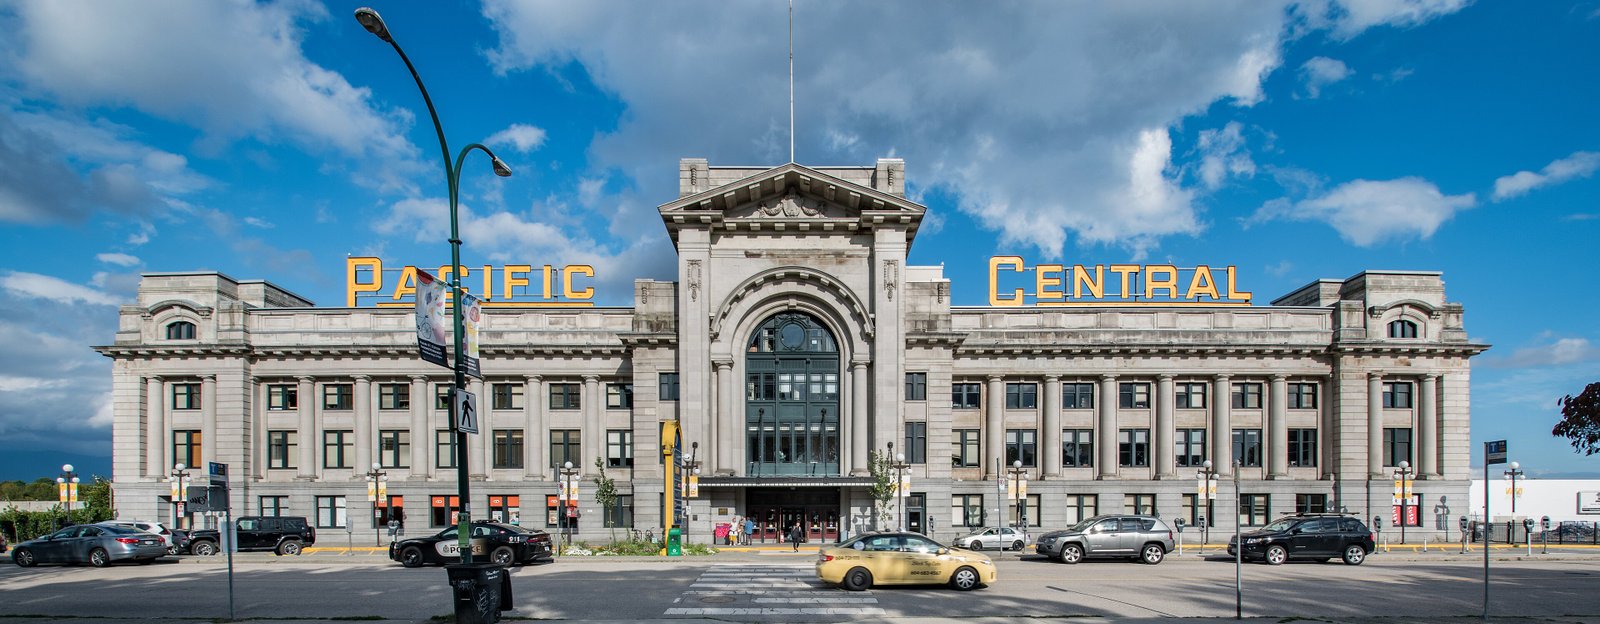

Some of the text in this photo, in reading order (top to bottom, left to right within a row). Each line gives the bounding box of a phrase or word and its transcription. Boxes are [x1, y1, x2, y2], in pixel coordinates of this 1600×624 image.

[346, 256, 595, 307] PACIFIC
[989, 255, 1252, 307] CENTRAL
[450, 546, 481, 554] POCE
